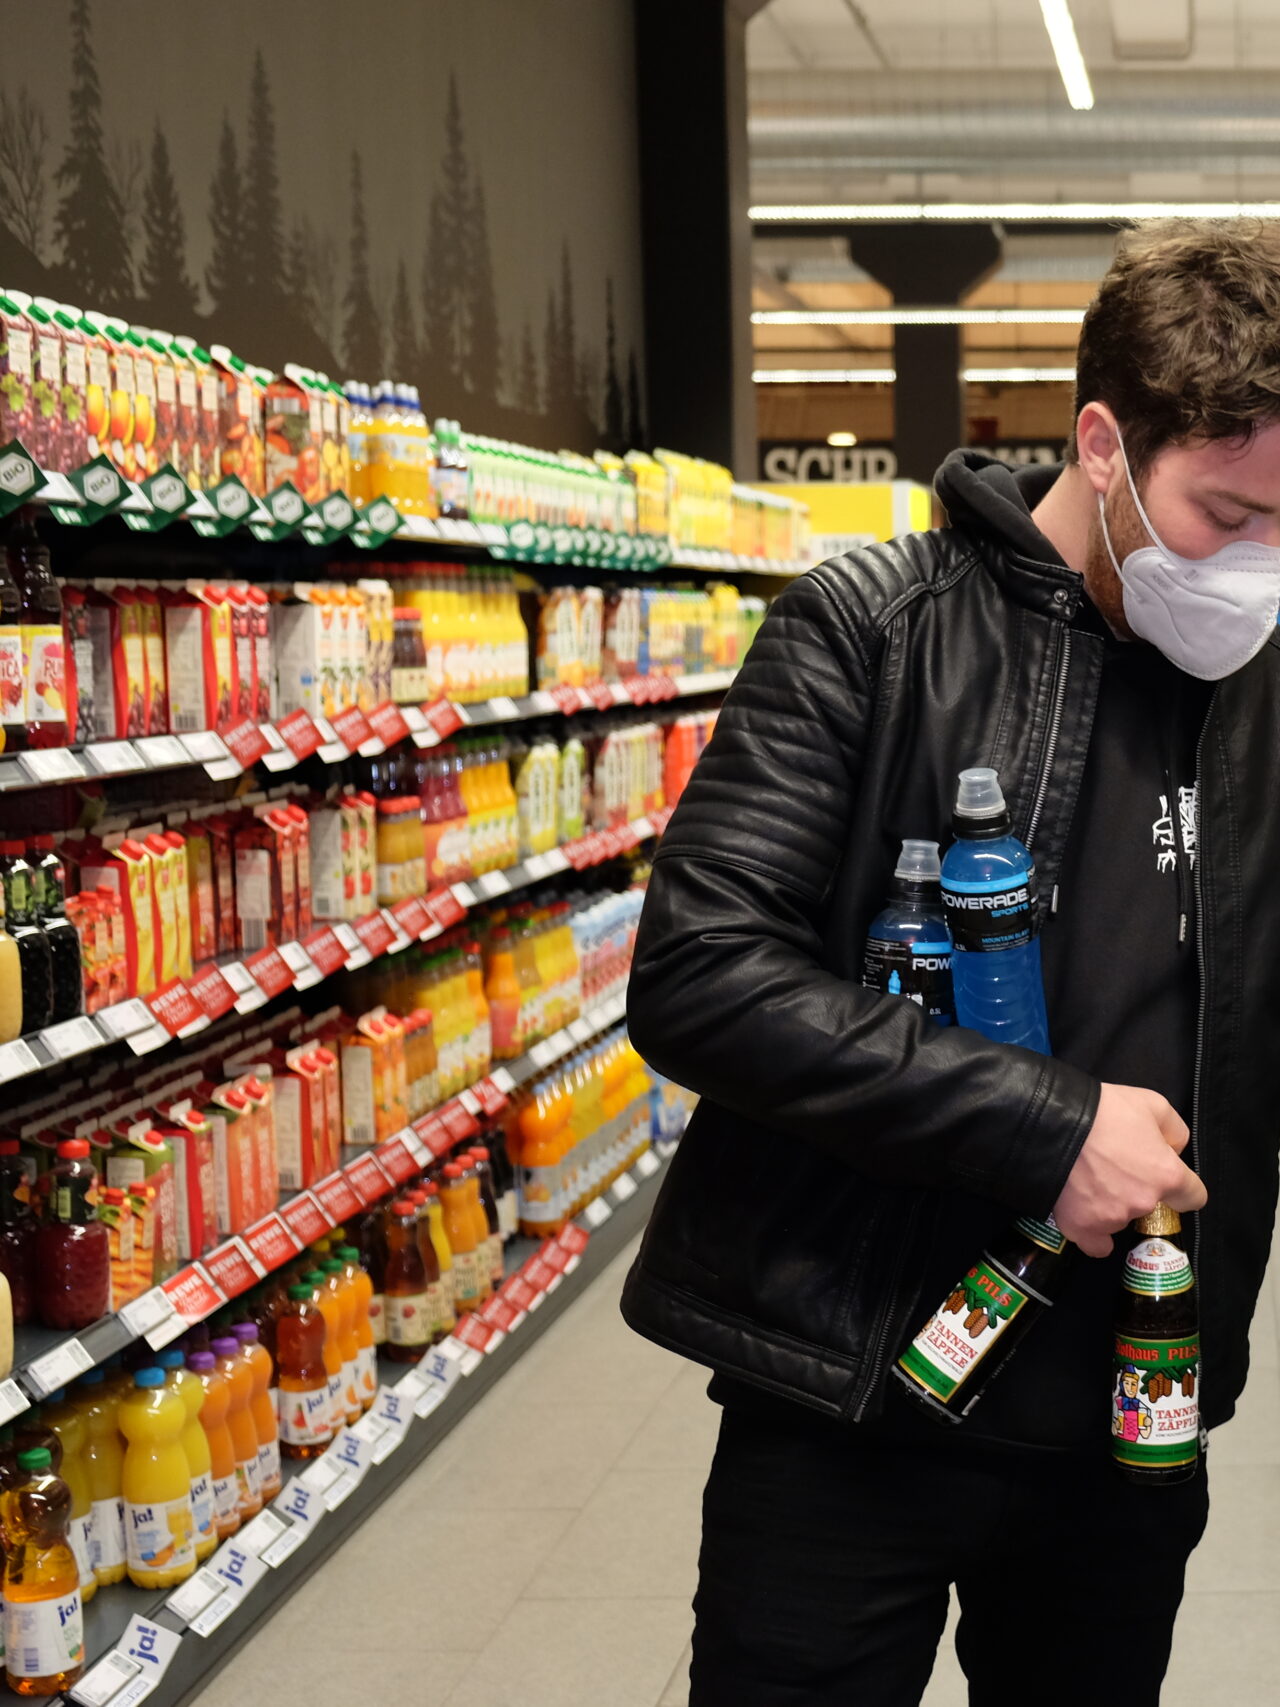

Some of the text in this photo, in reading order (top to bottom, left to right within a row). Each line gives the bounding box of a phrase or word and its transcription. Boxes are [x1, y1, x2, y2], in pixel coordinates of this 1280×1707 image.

[941, 888, 1029, 910] POWERADE
[992, 902, 1029, 918] SPORTS
[977, 1274, 1012, 1307] PILS
[926, 1330, 969, 1369] ZÄPFLE
[934, 1319, 978, 1360] TANNEN
[1168, 1345, 1198, 1361] PILS
[426, 1354, 448, 1382] ja!
[379, 1394, 401, 1423] ja!
[338, 1436, 361, 1468] ja!
[191, 1479, 207, 1501] ja!
[284, 1486, 311, 1521] ja!
[132, 1508, 154, 1529] ja!
[218, 1549, 247, 1587] ja!
[57, 1597, 78, 1626] ja!
[129, 1624, 159, 1664] ja!
